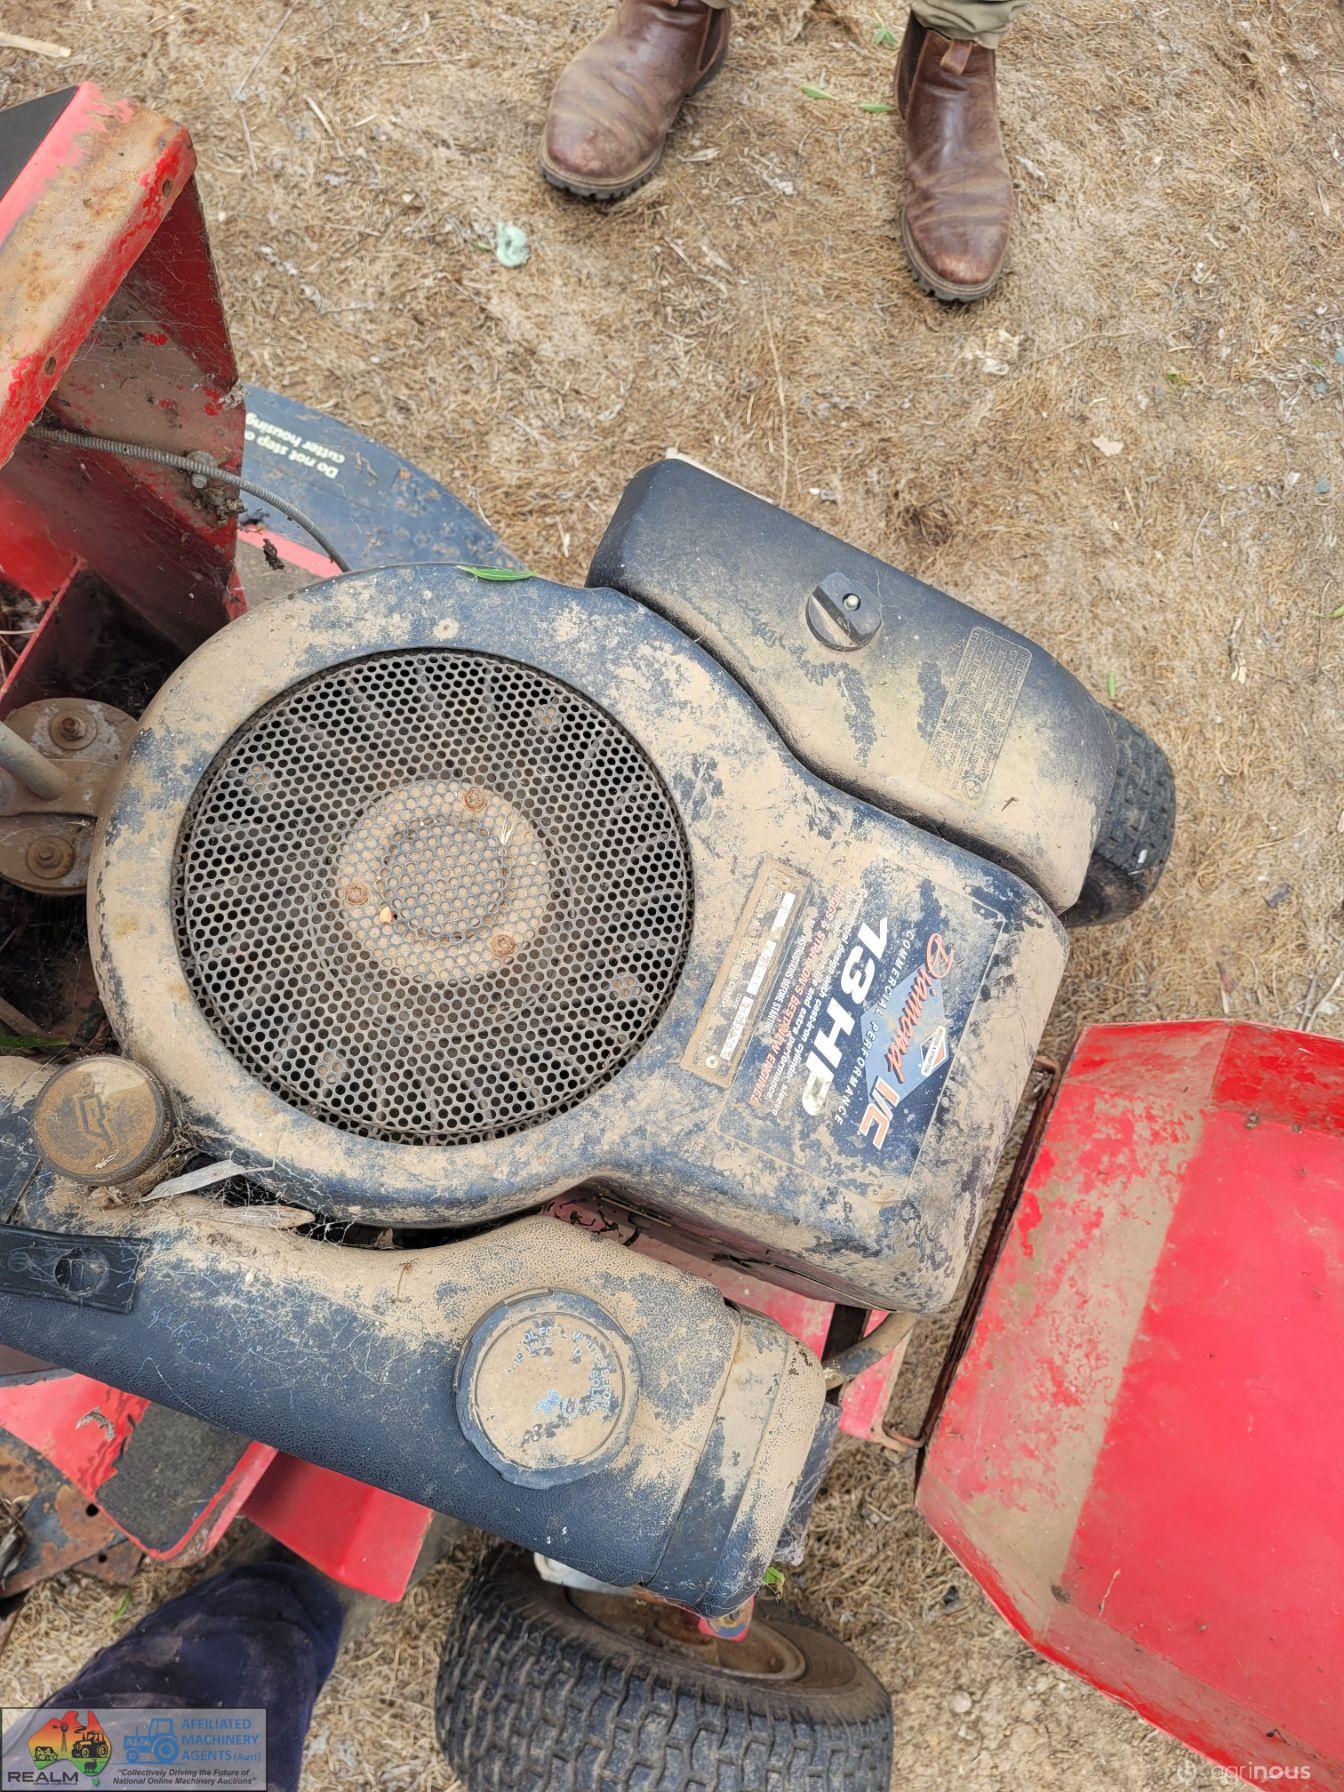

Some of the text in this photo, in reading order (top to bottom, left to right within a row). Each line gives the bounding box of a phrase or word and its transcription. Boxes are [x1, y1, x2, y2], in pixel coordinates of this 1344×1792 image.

[245, 431, 339, 479] Do not step o
[246, 412, 345, 463] cutter housing
[785, 934, 808, 979] INSTRUCTIONS
[827, 943, 844, 974] design
[774, 976, 790, 1003] BEFORE
[802, 986, 815, 1008] and
[818, 975, 831, 998] with
[887, 934, 952, 1083] Diamond
[792, 1007, 807, 1034] extra
[800, 917, 886, 1114] 13 HP
[800, 998, 822, 1042] cast-iron
[833, 929, 914, 1125] COMMERCIAL PERFORMANCE
[771, 1083, 787, 1116] sleeve
